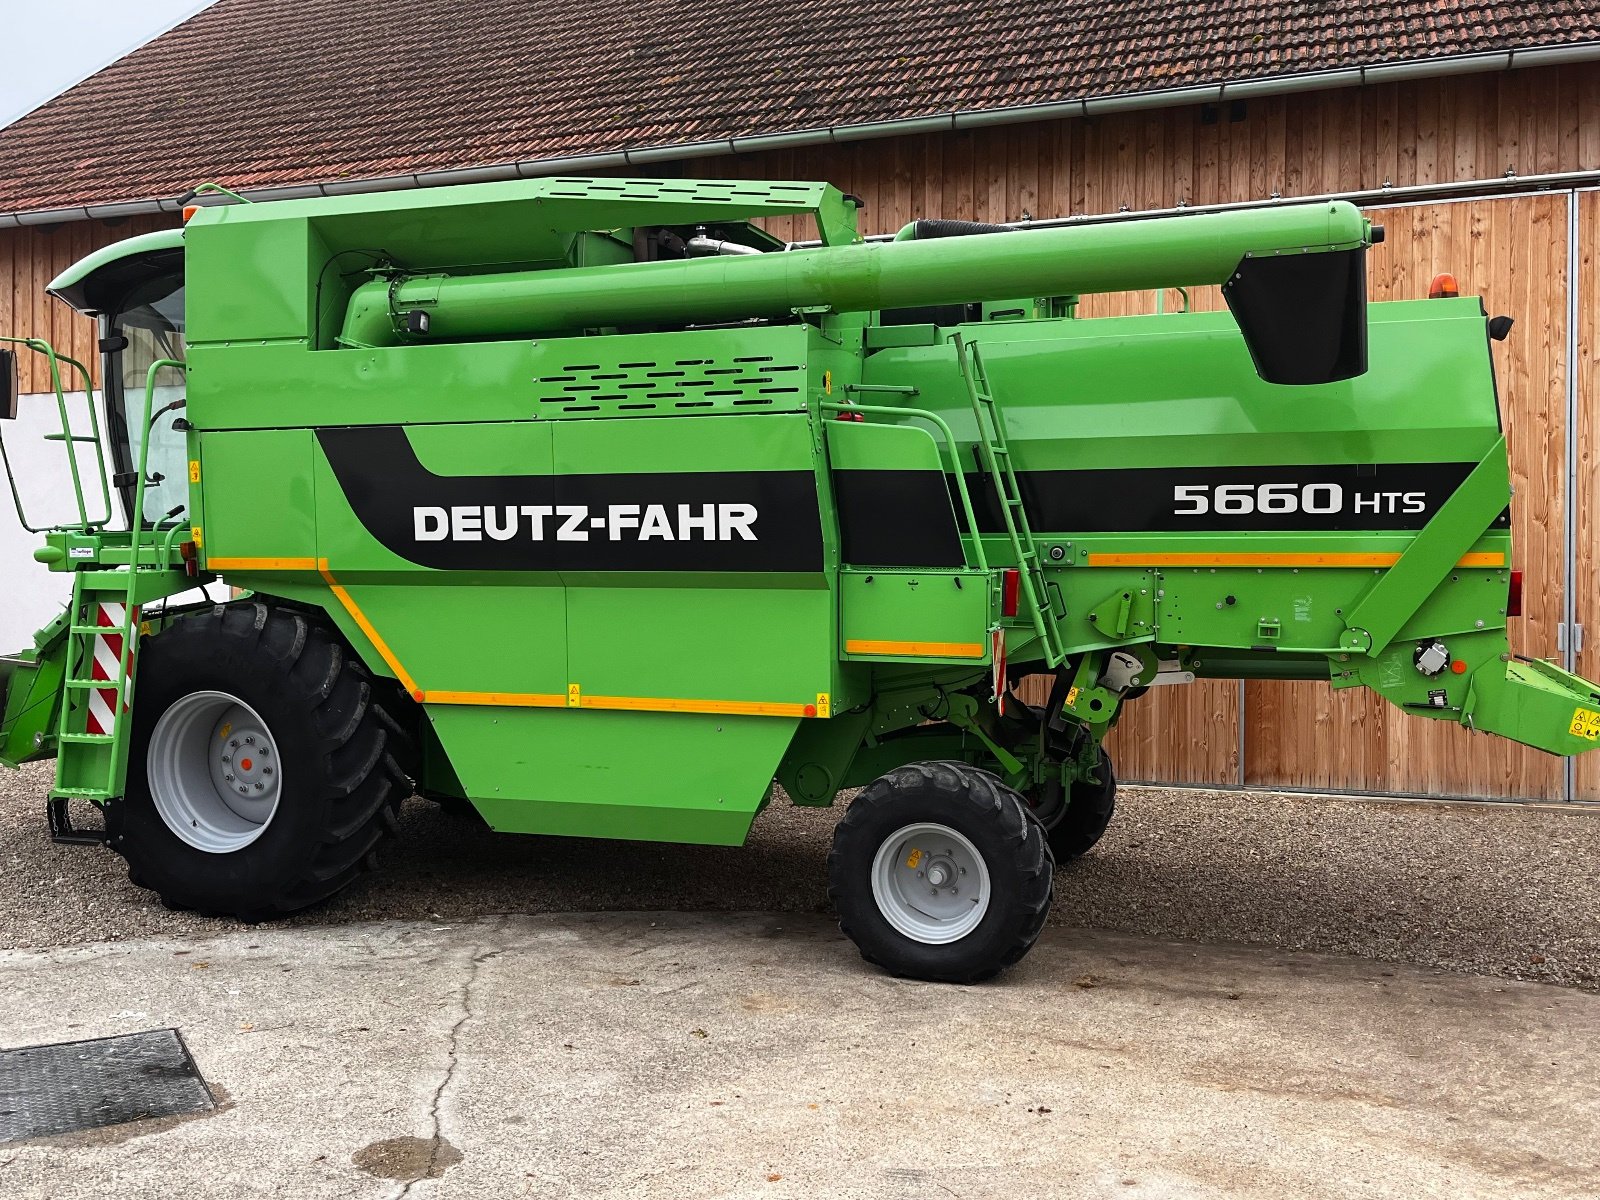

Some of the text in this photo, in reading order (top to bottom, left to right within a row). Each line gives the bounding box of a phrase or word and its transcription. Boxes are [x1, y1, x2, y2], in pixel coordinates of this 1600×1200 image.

[1174, 484, 1426, 515] 5660 HTS
[413, 503, 759, 542] DEUTZ-FAHR
